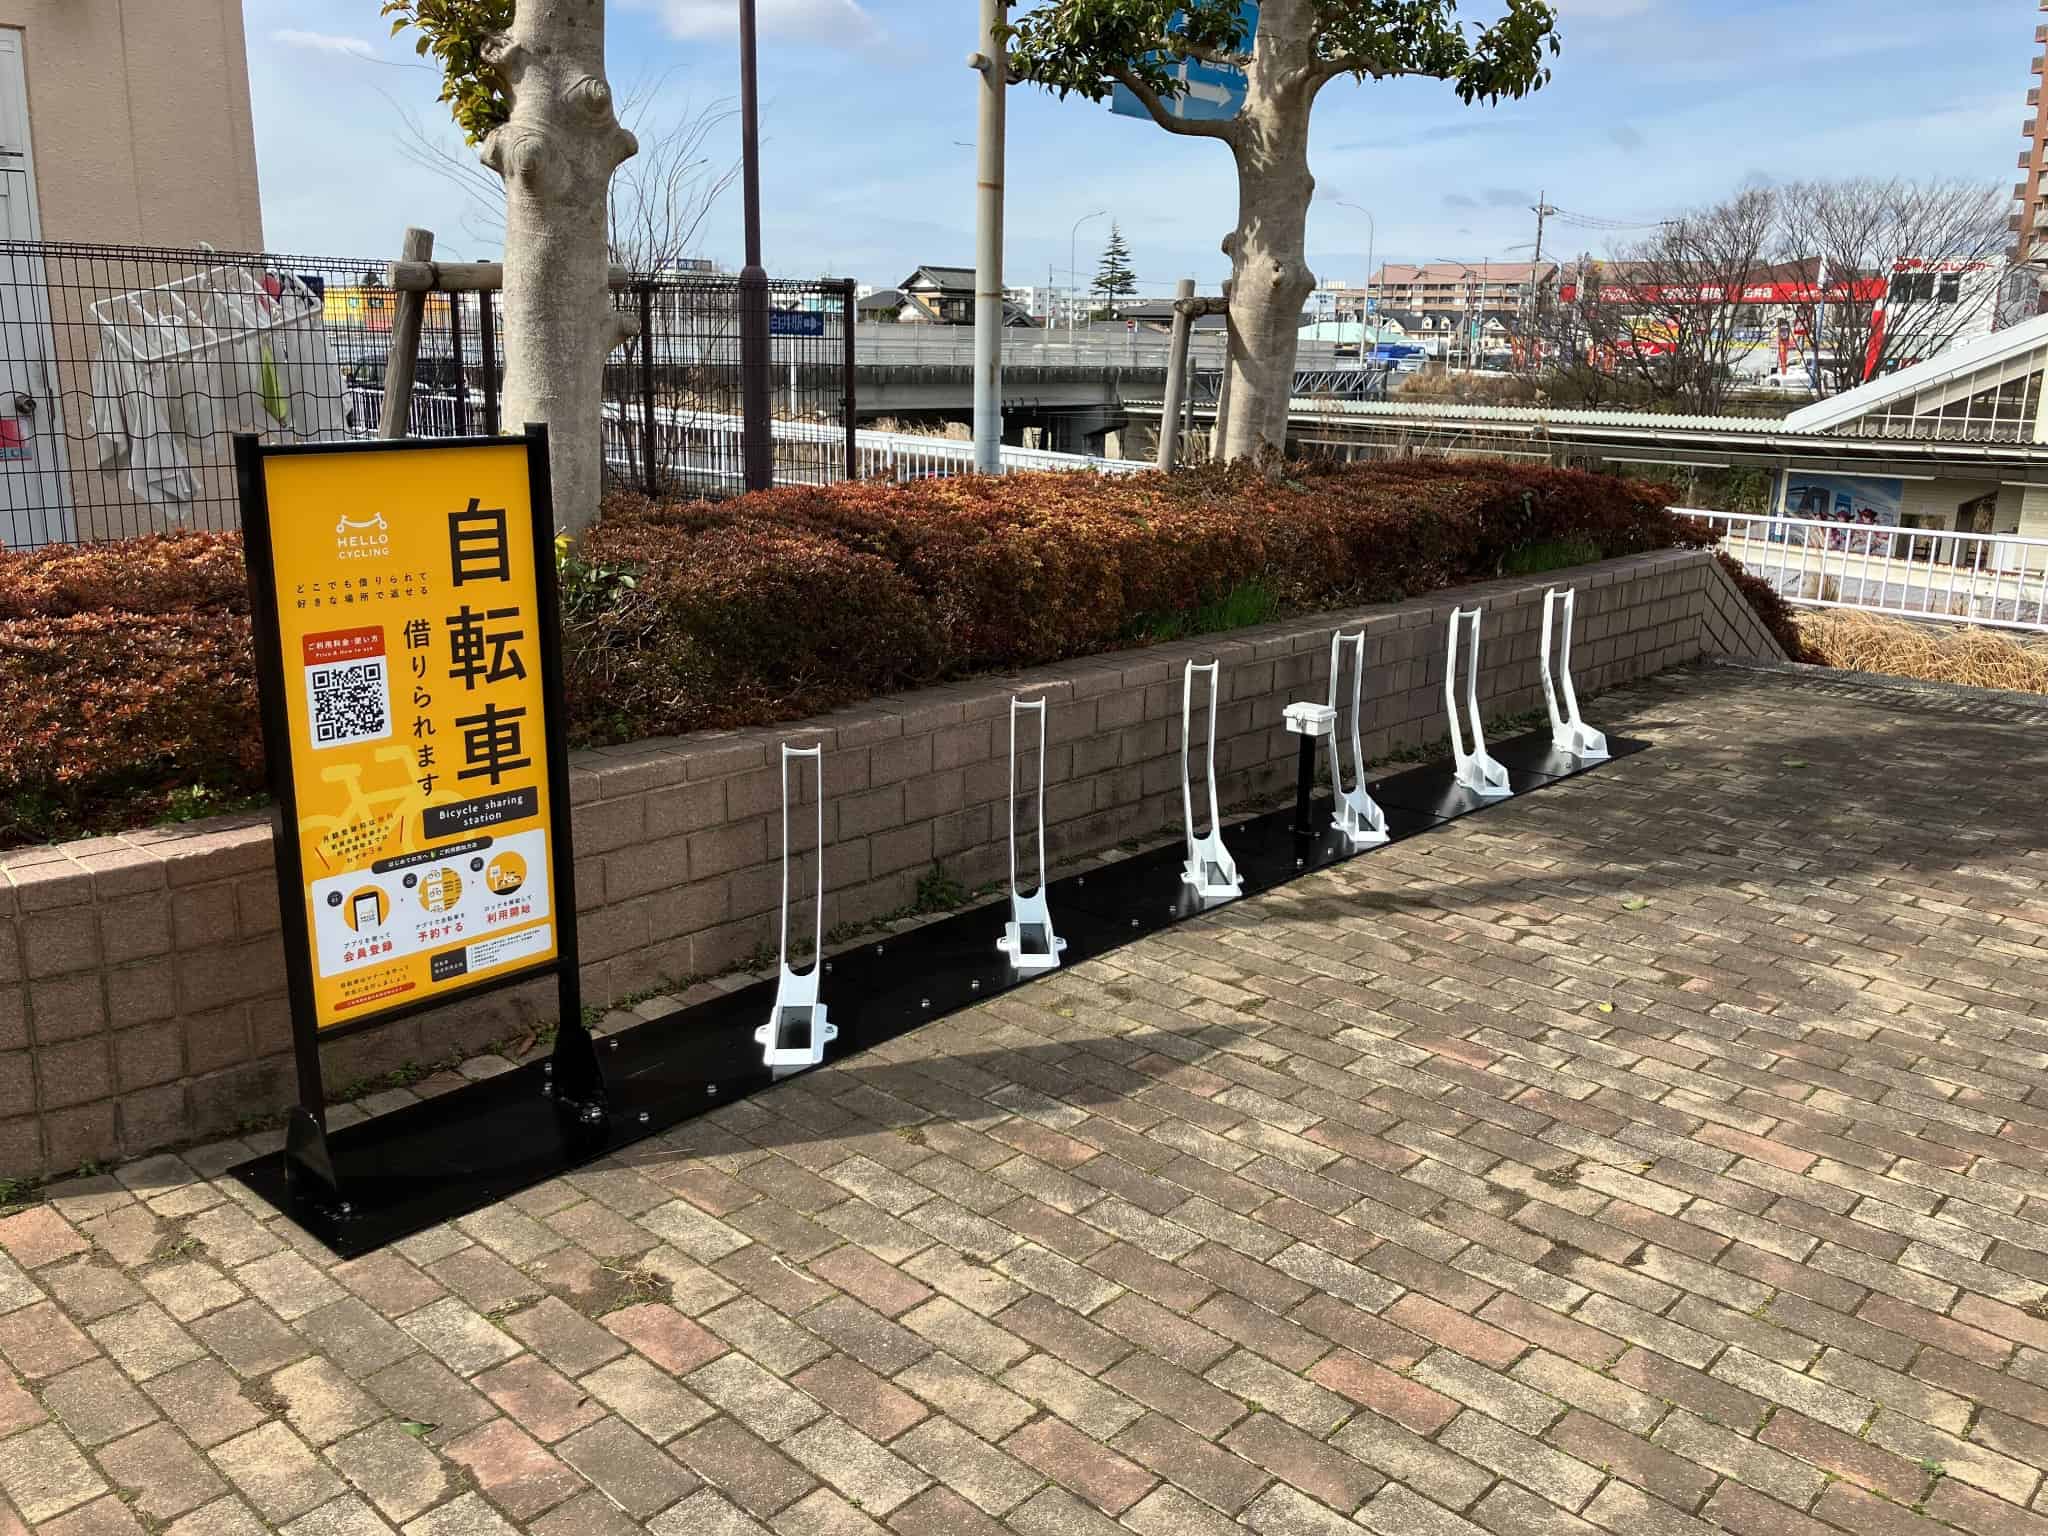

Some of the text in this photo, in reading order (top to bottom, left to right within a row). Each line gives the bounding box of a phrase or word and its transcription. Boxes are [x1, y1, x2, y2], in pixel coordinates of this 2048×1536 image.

[1743, 287, 1773, 299] 白井店
[337, 534, 388, 548] HELLO
[338, 547, 390, 560] CYCLING
[297, 572, 428, 594] どこでも借りられて
[297, 586, 428, 608] 好きな場所で返せる
[446, 498, 531, 785] 自転車
[404, 619, 439, 796] 借りられます
[439, 794, 524, 820] Bicycle sharing
[463, 811, 502, 827] station
[487, 904, 531, 923] 利用開始
[418, 922, 464, 942] 予約する
